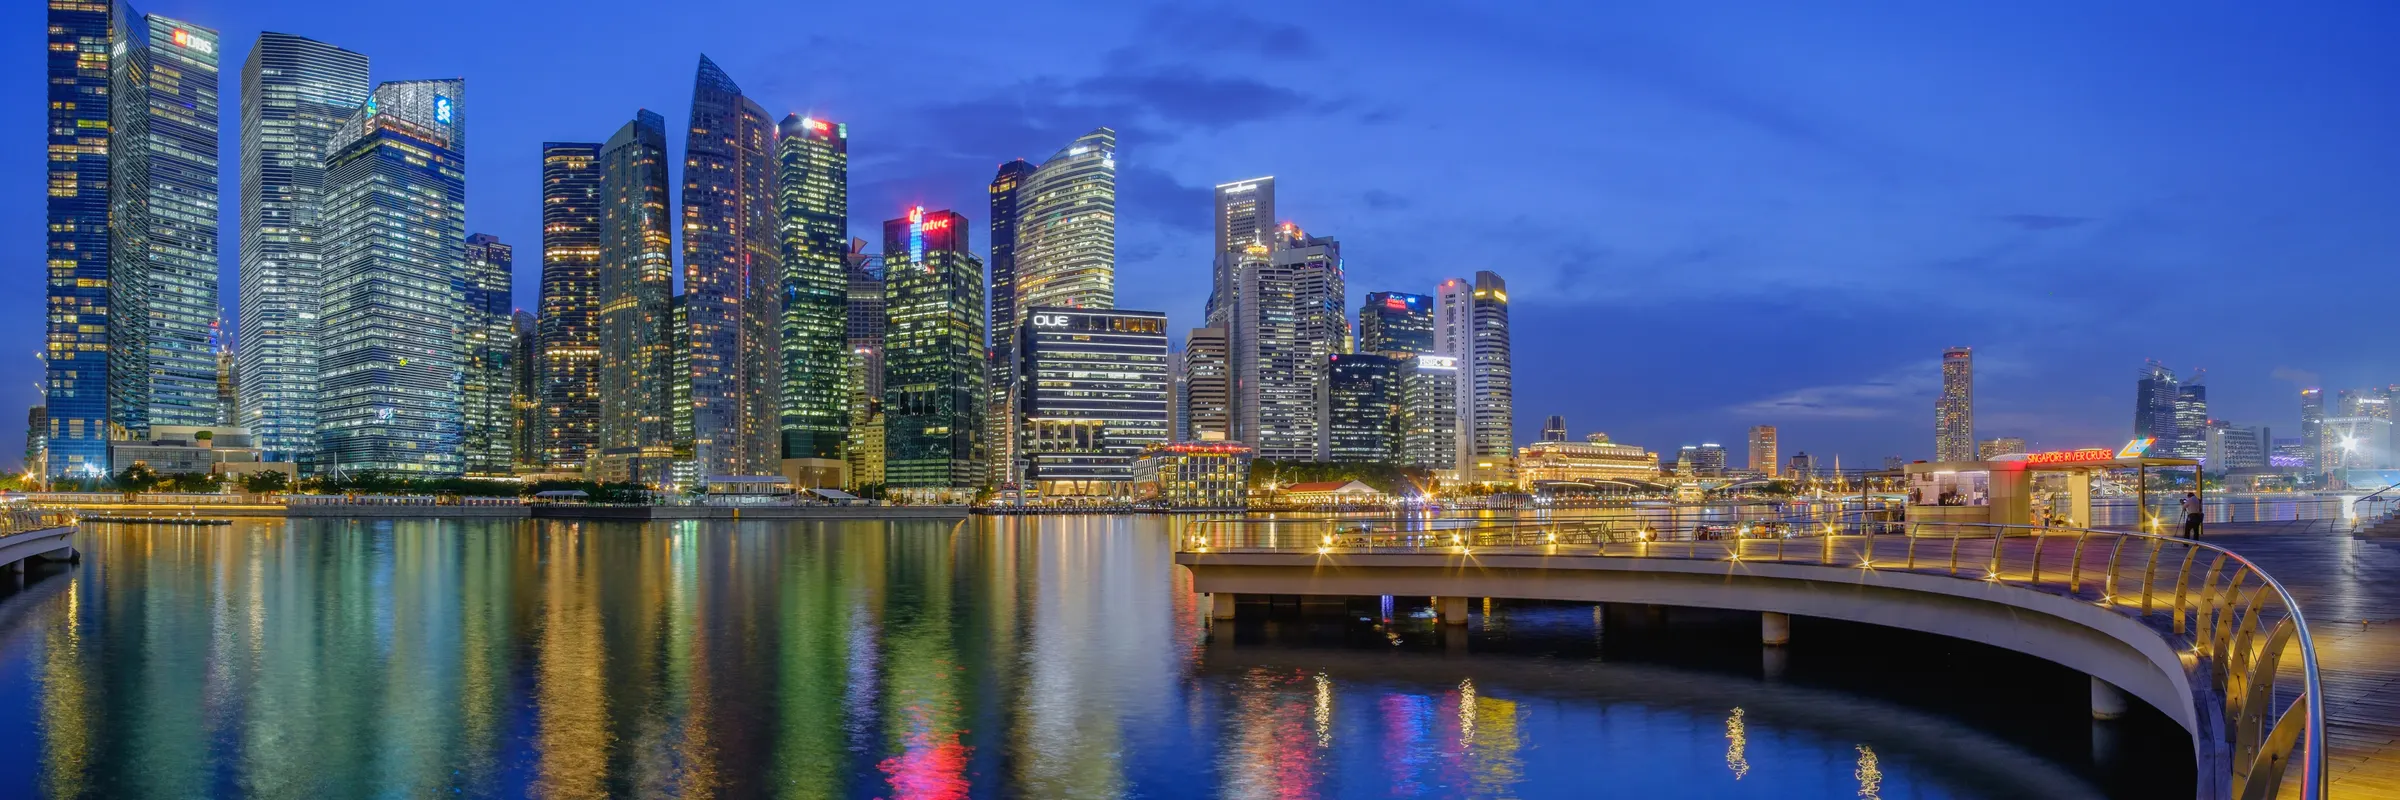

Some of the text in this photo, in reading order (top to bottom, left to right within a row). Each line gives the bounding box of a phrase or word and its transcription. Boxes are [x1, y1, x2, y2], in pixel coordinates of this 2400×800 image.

[187, 34, 212, 53] DBS
[1033, 315, 1069, 327] OUE
[2027, 449, 2112, 463] SINGAPORE RIVER CRUISE
